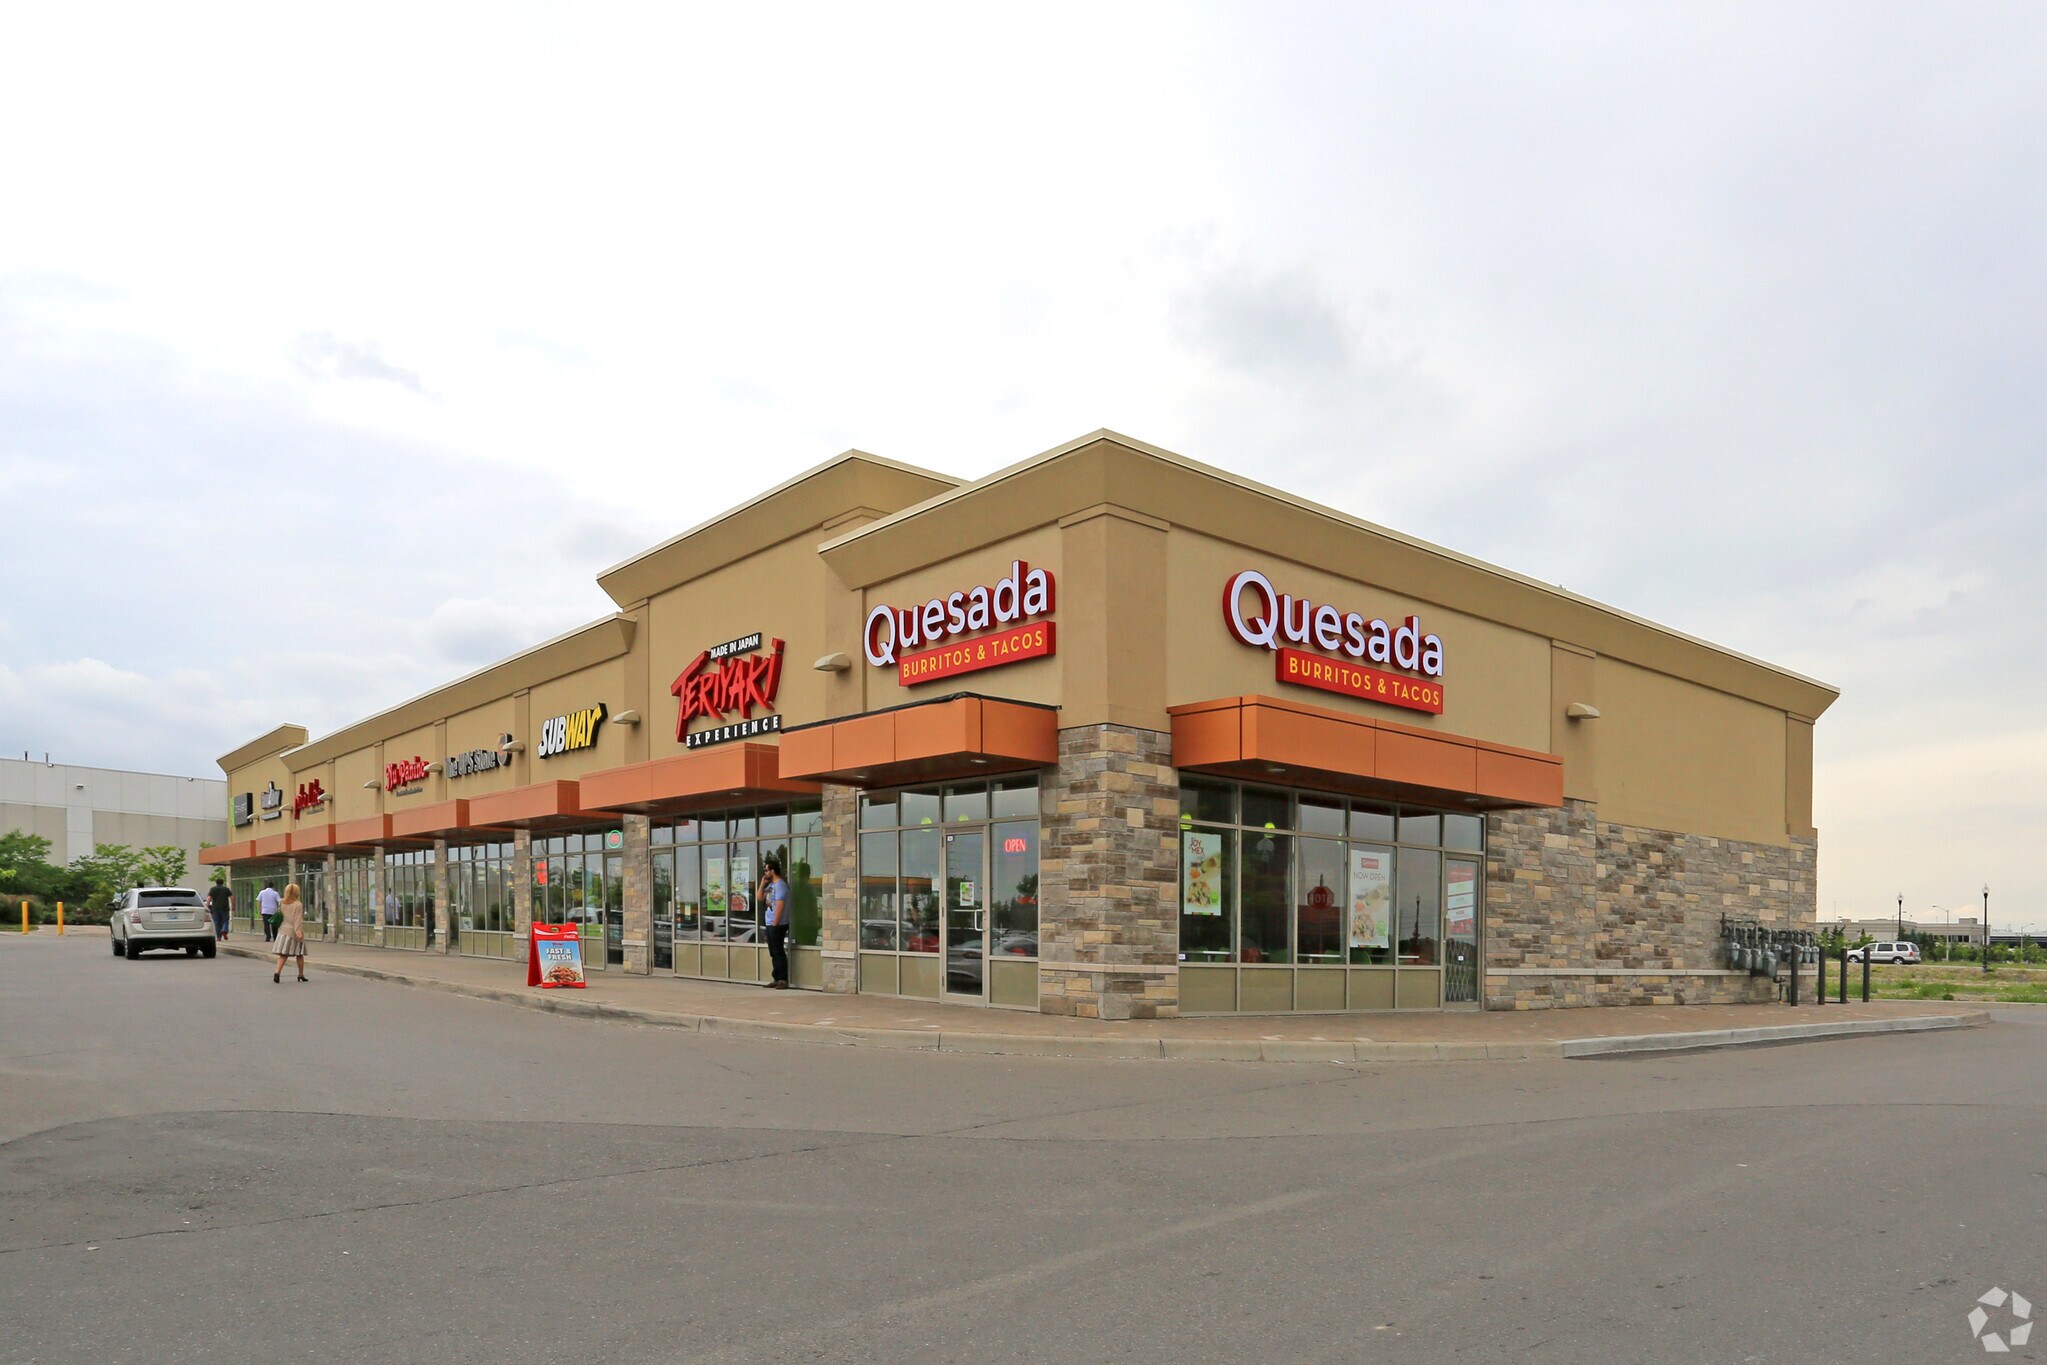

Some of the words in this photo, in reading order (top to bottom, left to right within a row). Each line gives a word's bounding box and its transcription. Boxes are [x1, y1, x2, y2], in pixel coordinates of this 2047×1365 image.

[865, 560, 1051, 667] Quesada
[1227, 570, 1443, 677] Quesada
[711, 644, 728, 659] MADE
[730, 641, 737, 653] IN
[738, 635, 759, 650] JAPAN
[903, 647, 971, 678] BURRITOS
[977, 645, 986, 660] &
[992, 630, 1043, 656] TACOS
[671, 637, 785, 742] TERIYAKI
[1290, 657, 1371, 690] BURRITOS
[1377, 678, 1386, 694] &
[1392, 681, 1439, 706] TACOS
[538, 705, 602, 757] SUBWAY
[686, 716, 779, 747] EXPERIENCE
[1005, 838, 1026, 852] OPEN
[1353, 871, 1368, 880] NOW
[1369, 872, 1386, 881] OPEN
